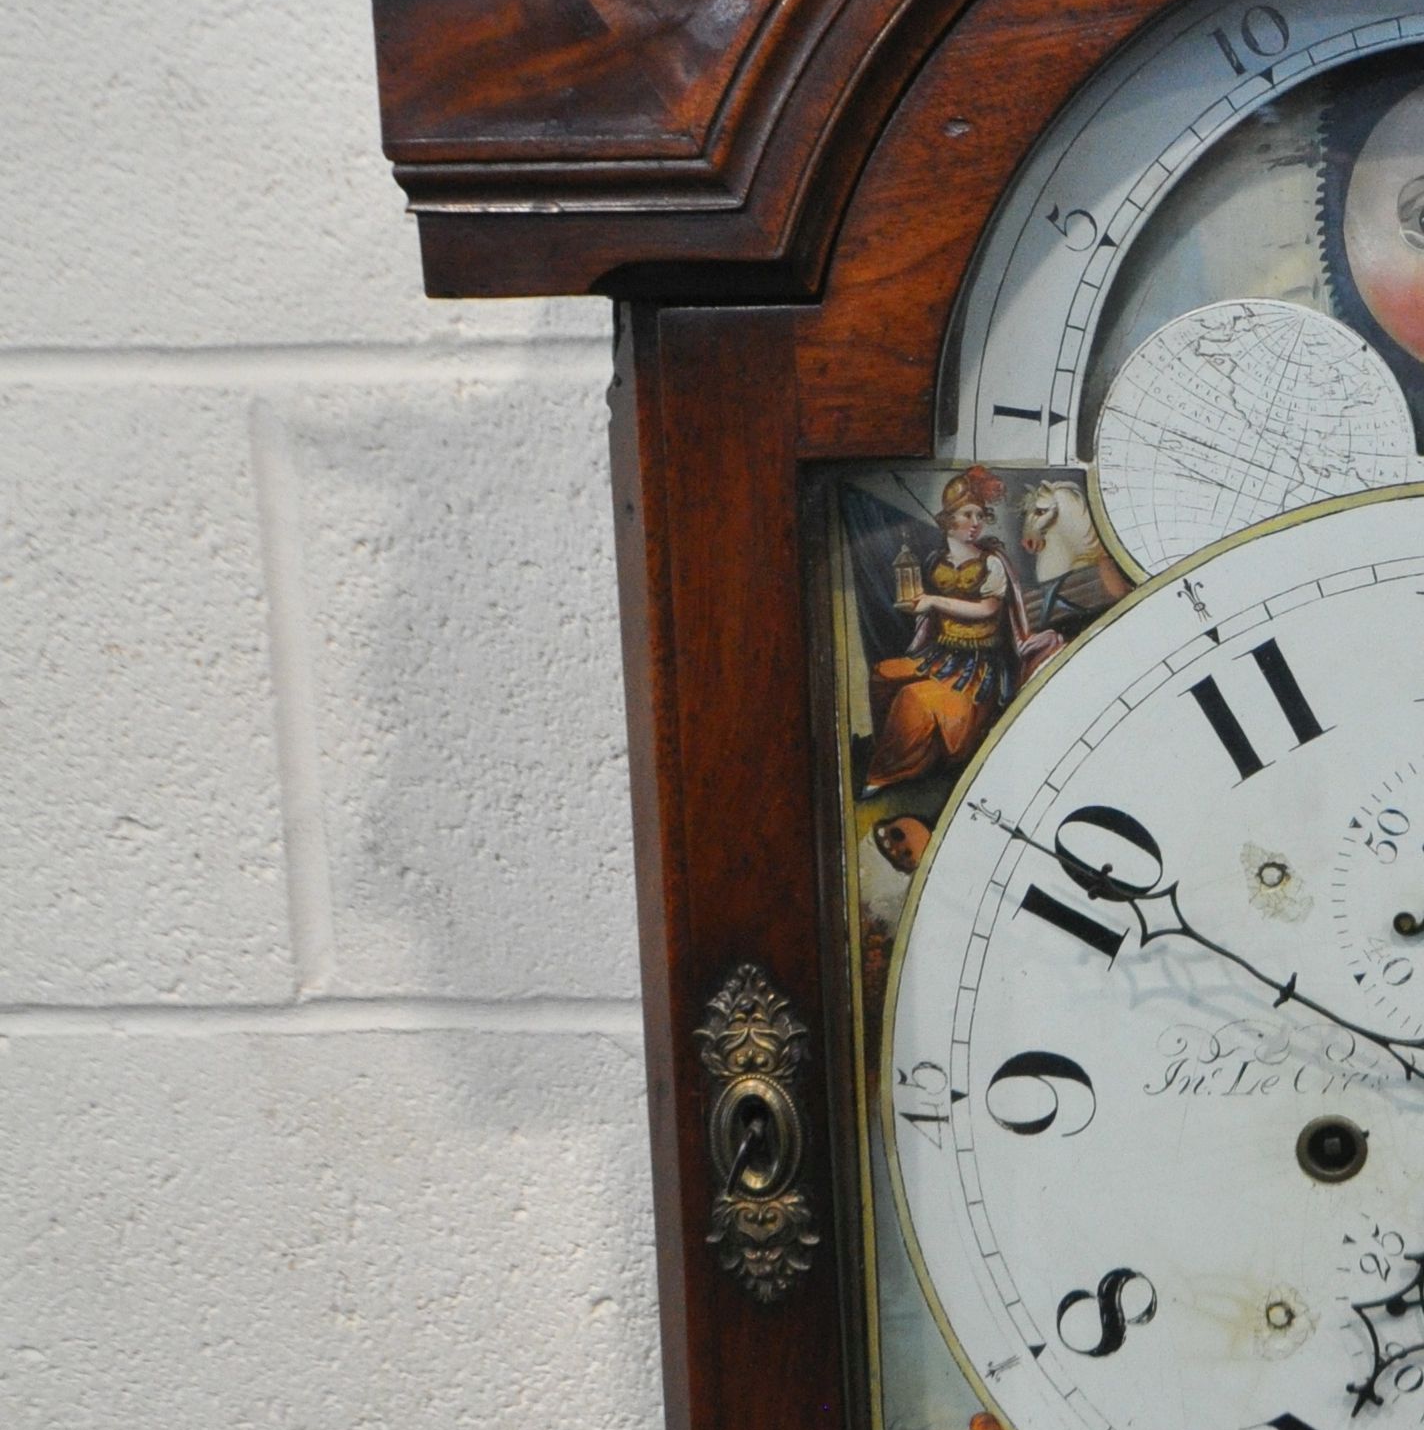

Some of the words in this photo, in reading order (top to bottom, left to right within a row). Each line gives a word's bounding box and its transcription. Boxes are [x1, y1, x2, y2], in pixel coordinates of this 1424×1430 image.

[1206, 4, 1290, 77] 10
[1045, 202, 1098, 252] 5
[991, 403, 1044, 427] 1
[1177, 636, 1338, 790] 11
[1364, 808, 1411, 865] 50
[1012, 805, 1163, 972] 10
[897, 1060, 950, 1150] 45
[985, 1050, 1097, 1138] 9
[1359, 1223, 1405, 1282] 25
[1055, 1267, 1158, 1358] 8
